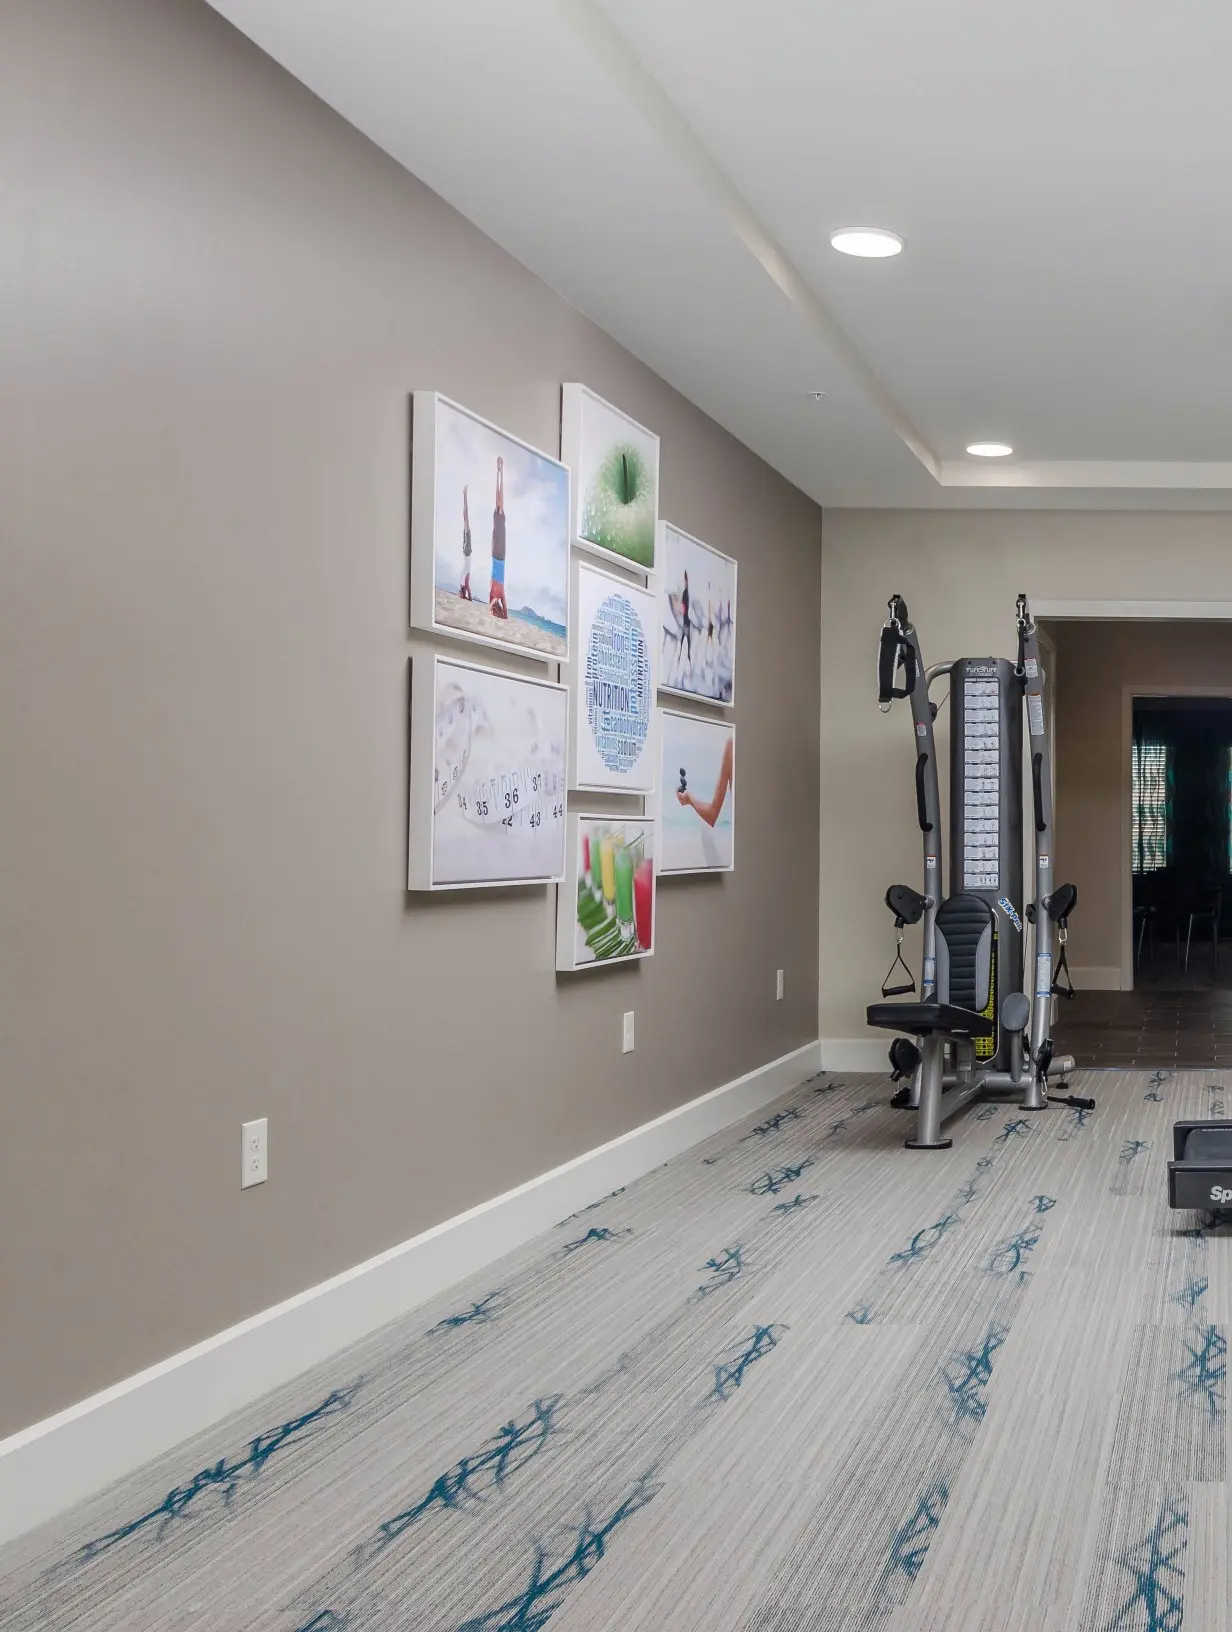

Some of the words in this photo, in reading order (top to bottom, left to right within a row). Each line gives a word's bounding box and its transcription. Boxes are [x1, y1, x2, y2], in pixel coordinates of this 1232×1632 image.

[611, 626, 625, 653] Iron
[585, 655, 593, 680] Iron
[592, 632, 600, 680] protein
[630, 628, 639, 715] potassium
[593, 680, 630, 712] NUTRITION
[601, 709, 611, 732] fat
[476, 800, 489, 816] 35
[504, 787, 519, 809] 36
[532, 773, 542, 792] 37
[529, 811, 541, 828] 43
[552, 803, 563, 818] 44
